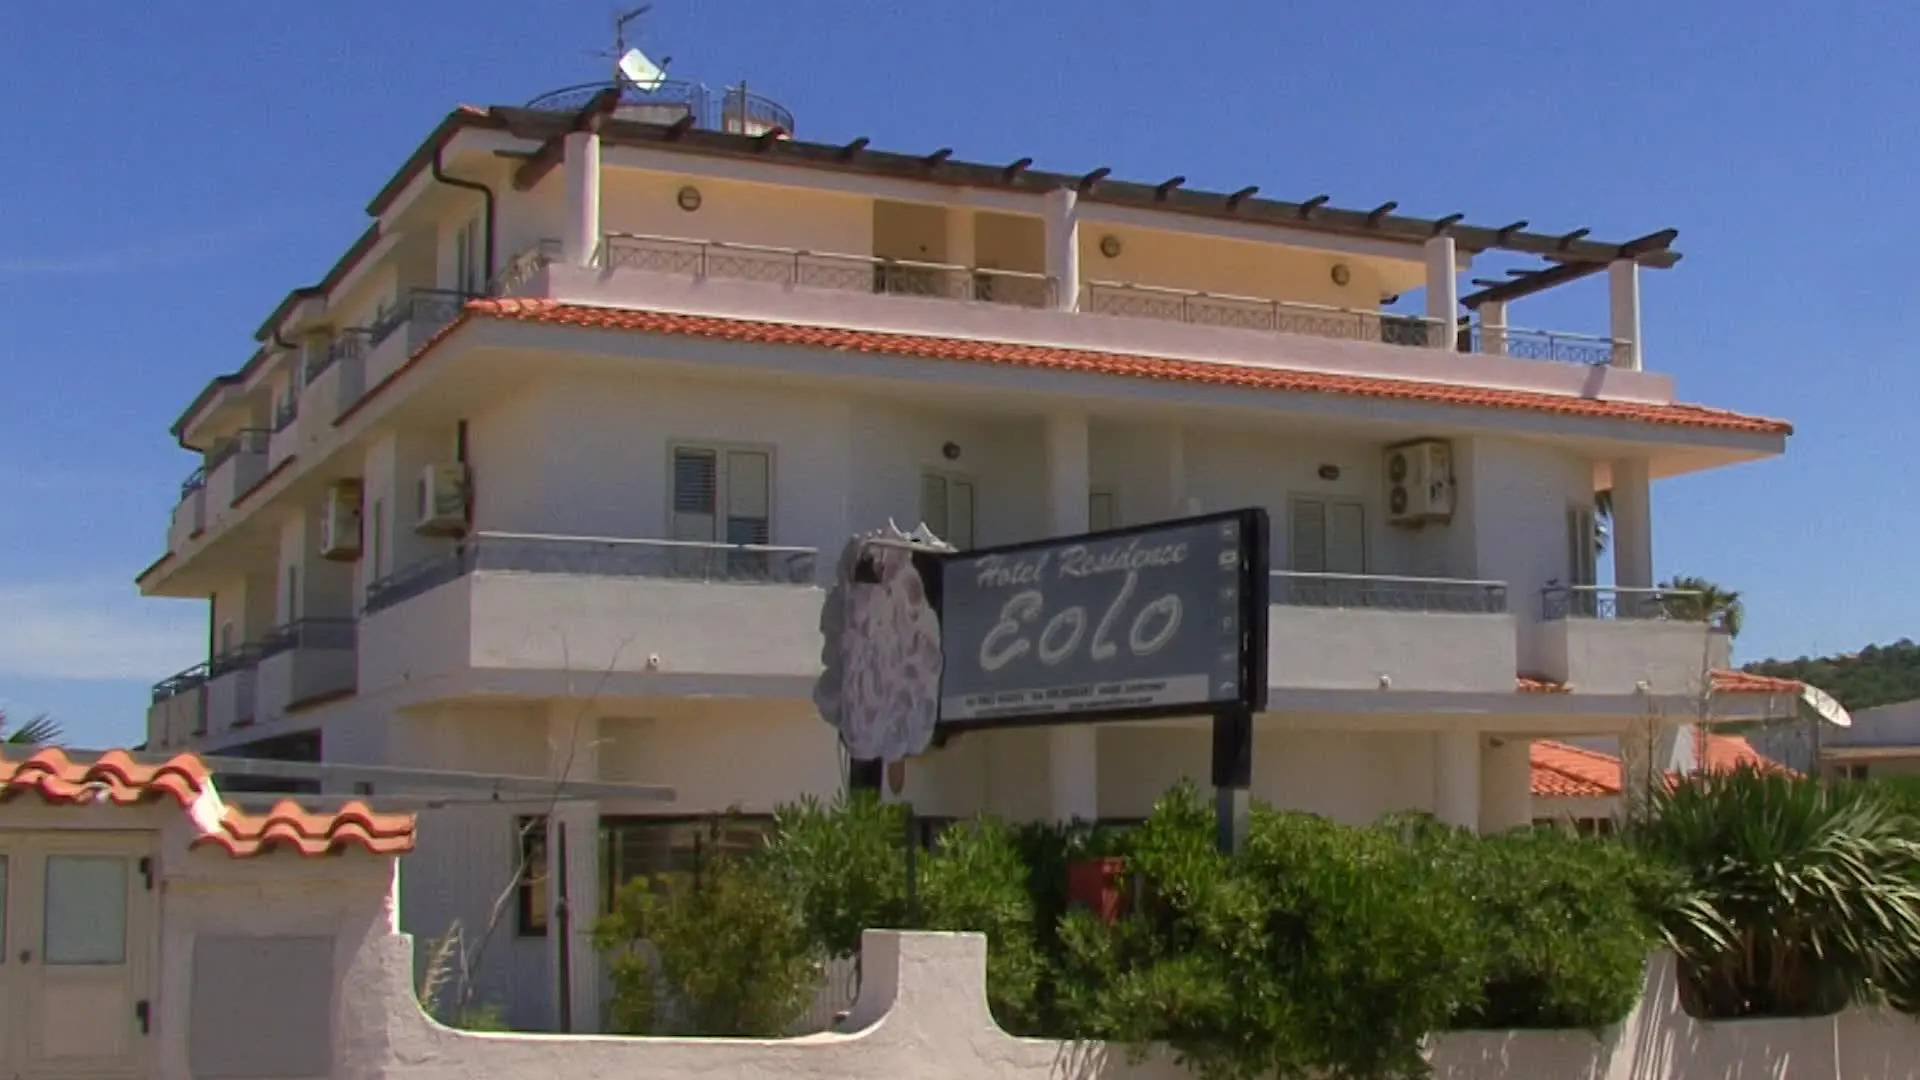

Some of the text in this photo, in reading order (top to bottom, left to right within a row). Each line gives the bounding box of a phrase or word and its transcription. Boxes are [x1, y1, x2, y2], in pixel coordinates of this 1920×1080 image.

[975, 538, 1189, 588] Hotel Residence
[979, 571, 1183, 672] Eolo
